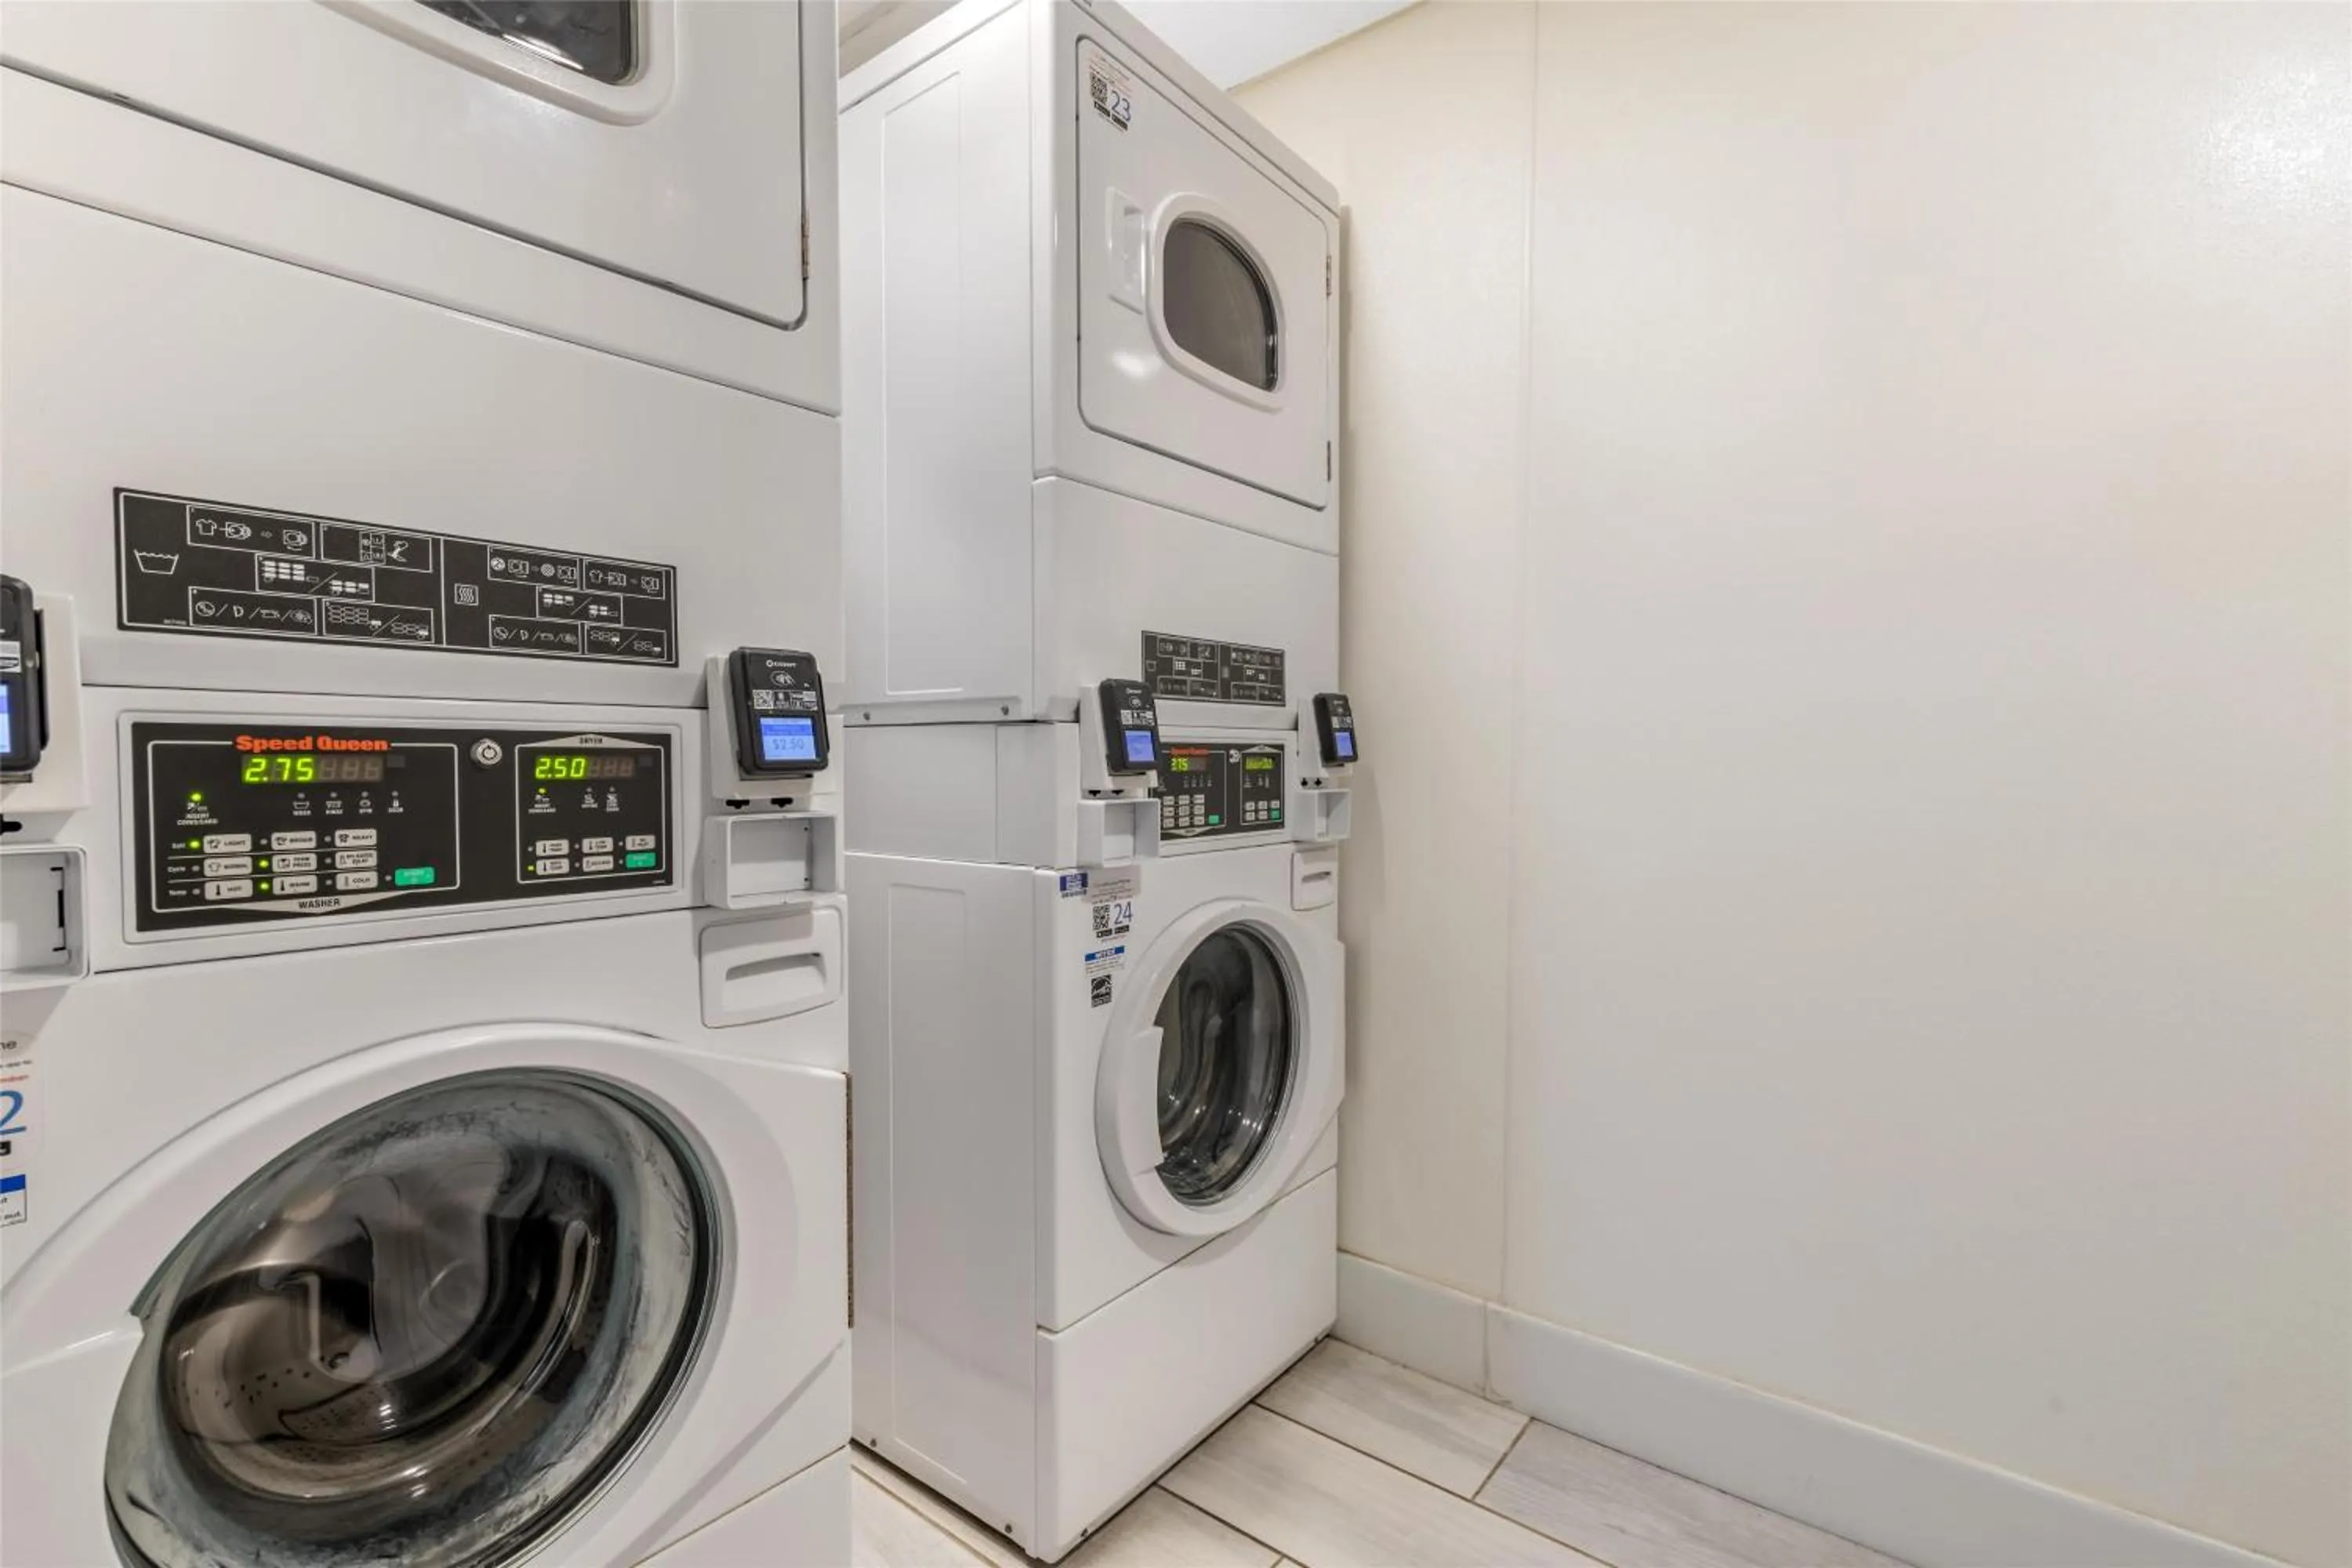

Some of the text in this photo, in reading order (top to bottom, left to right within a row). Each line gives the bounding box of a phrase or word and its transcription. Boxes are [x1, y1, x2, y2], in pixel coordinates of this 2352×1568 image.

[1111, 90, 1131, 122] 23
[236, 734, 389, 753] Speed Queen
[245, 757, 314, 782] 2.75
[535, 757, 586, 779] 2.50
[299, 898, 342, 909] WASHER
[1113, 902, 1133, 925] 24
